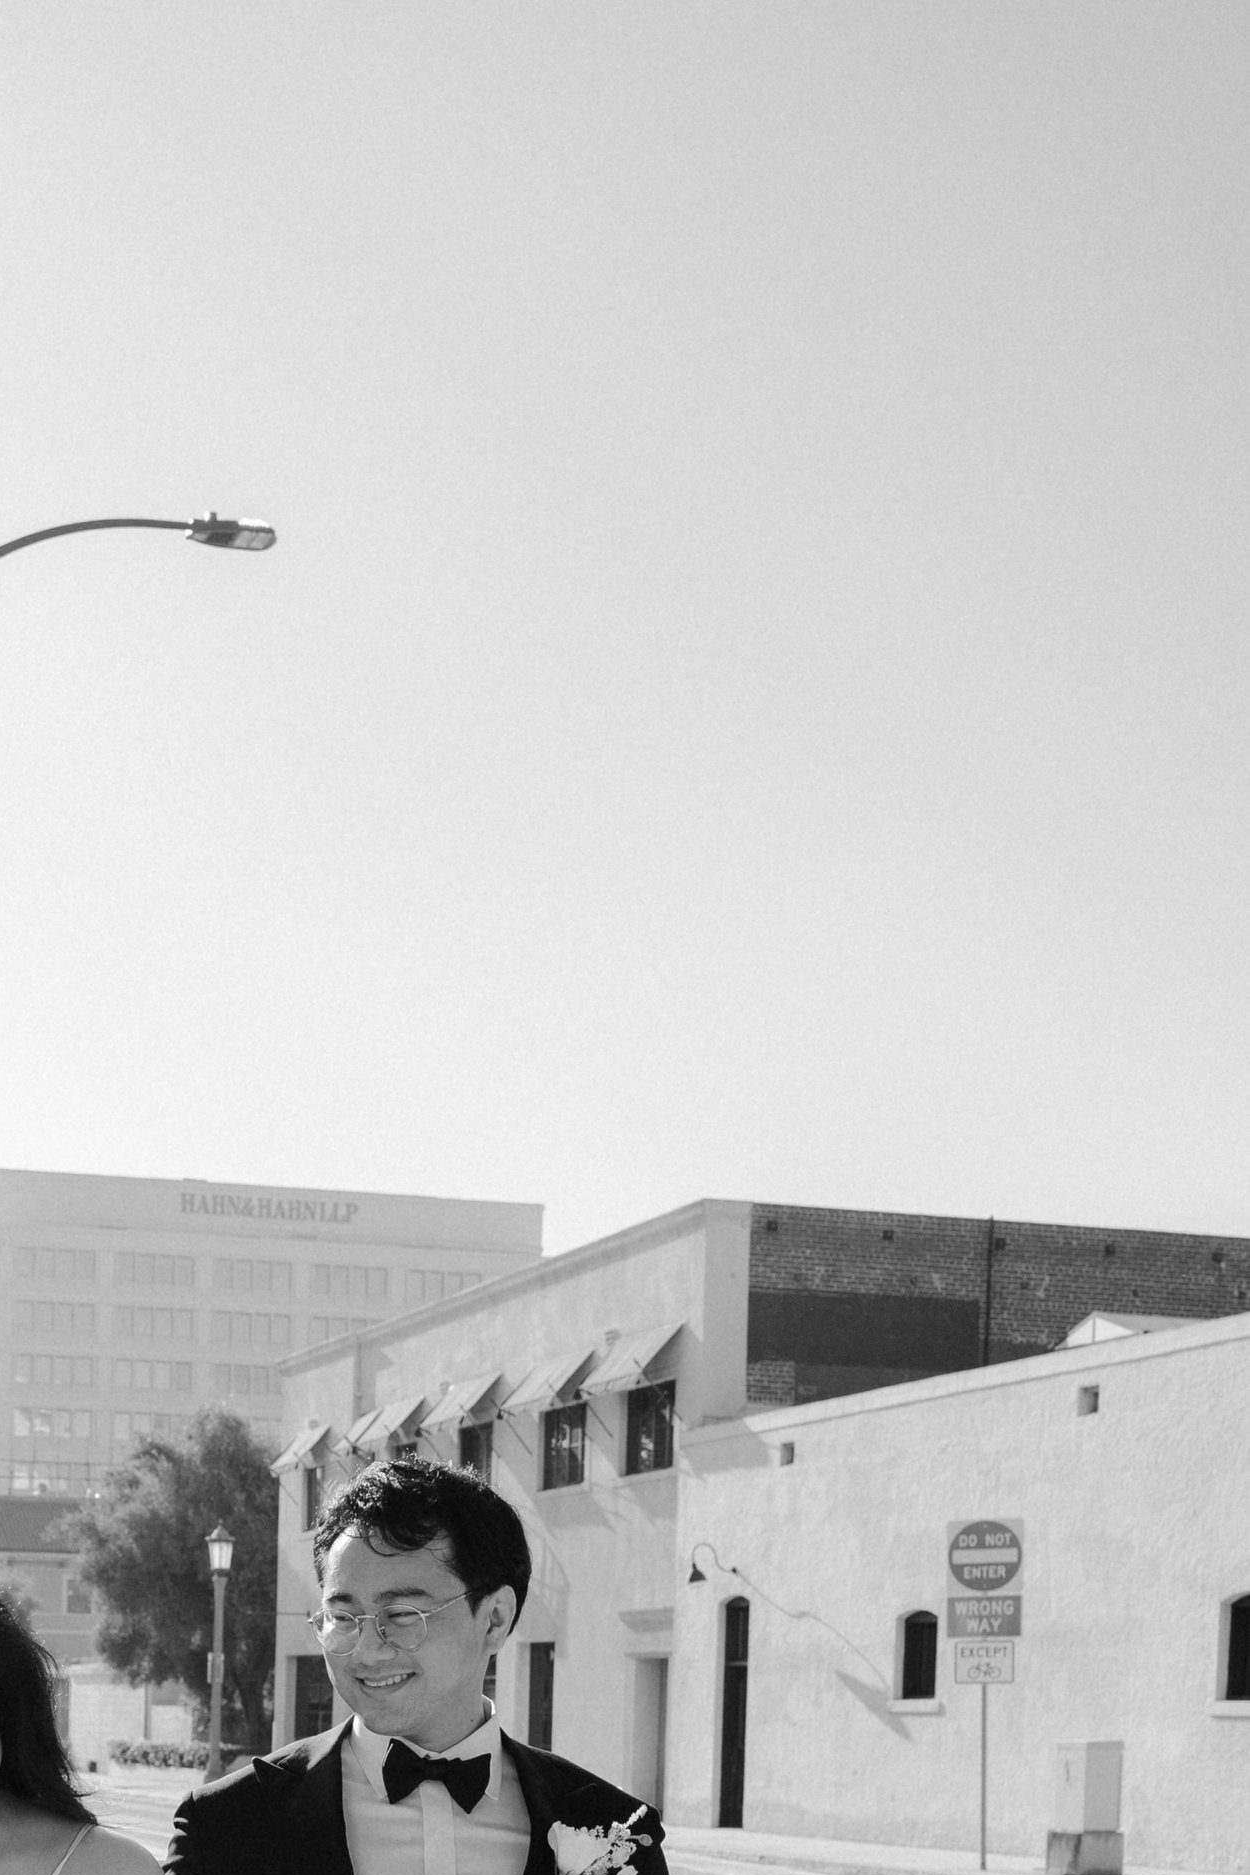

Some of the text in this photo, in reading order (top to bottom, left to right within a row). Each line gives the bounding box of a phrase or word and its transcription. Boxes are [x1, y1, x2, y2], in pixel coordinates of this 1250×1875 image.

[959, 1532, 1011, 1547] DO NOT
[963, 1565, 1006, 1579] ENTER
[955, 1600, 1014, 1616] WRONG
[966, 1618, 1002, 1633] WAY
[961, 1646, 1007, 1658] EXCEPT
